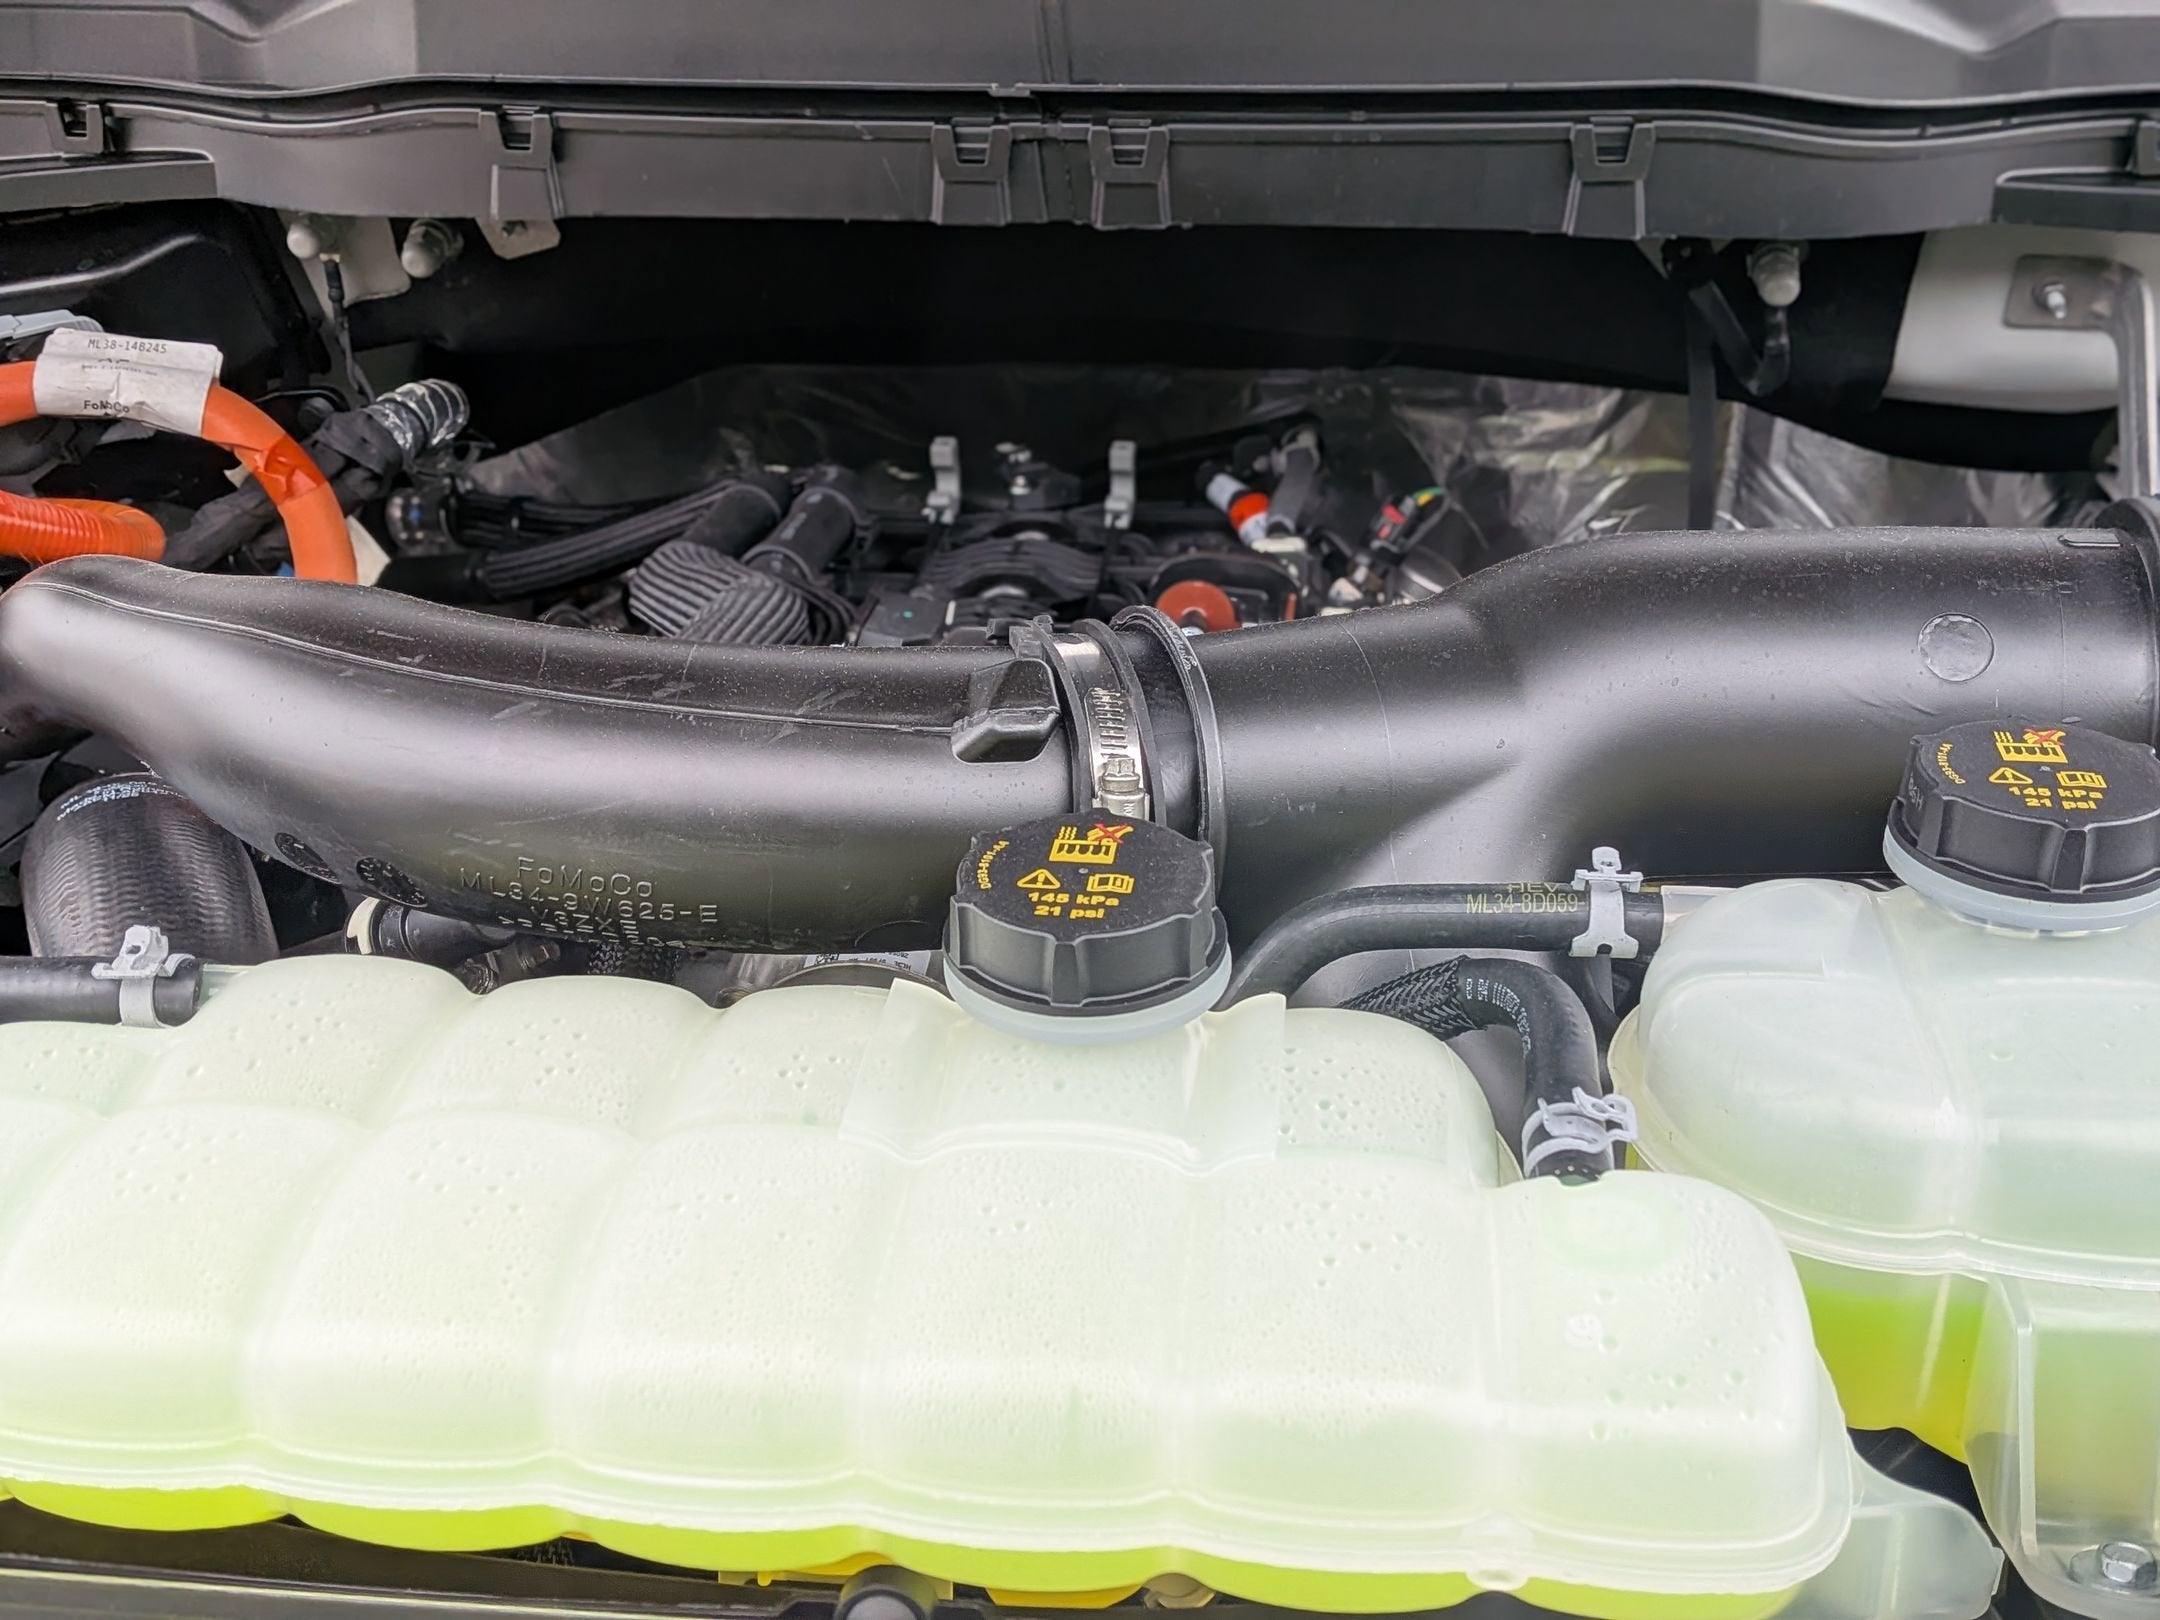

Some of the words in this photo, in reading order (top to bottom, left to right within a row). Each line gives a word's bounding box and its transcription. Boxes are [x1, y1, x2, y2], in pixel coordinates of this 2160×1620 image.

[87, 338, 168, 354] ML38-14B245
[2008, 785, 2052, 798] 145
[2057, 786, 2103, 800] kPa
[2025, 798, 2053, 808] 21
[2061, 799, 2097, 810] psi
[516, 856, 655, 898] FoMoCo
[1028, 891, 1070, 904] 145
[1075, 893, 1120, 907] kPa
[1034, 904, 1062, 917] 21
[1069, 906, 1106, 920] psi
